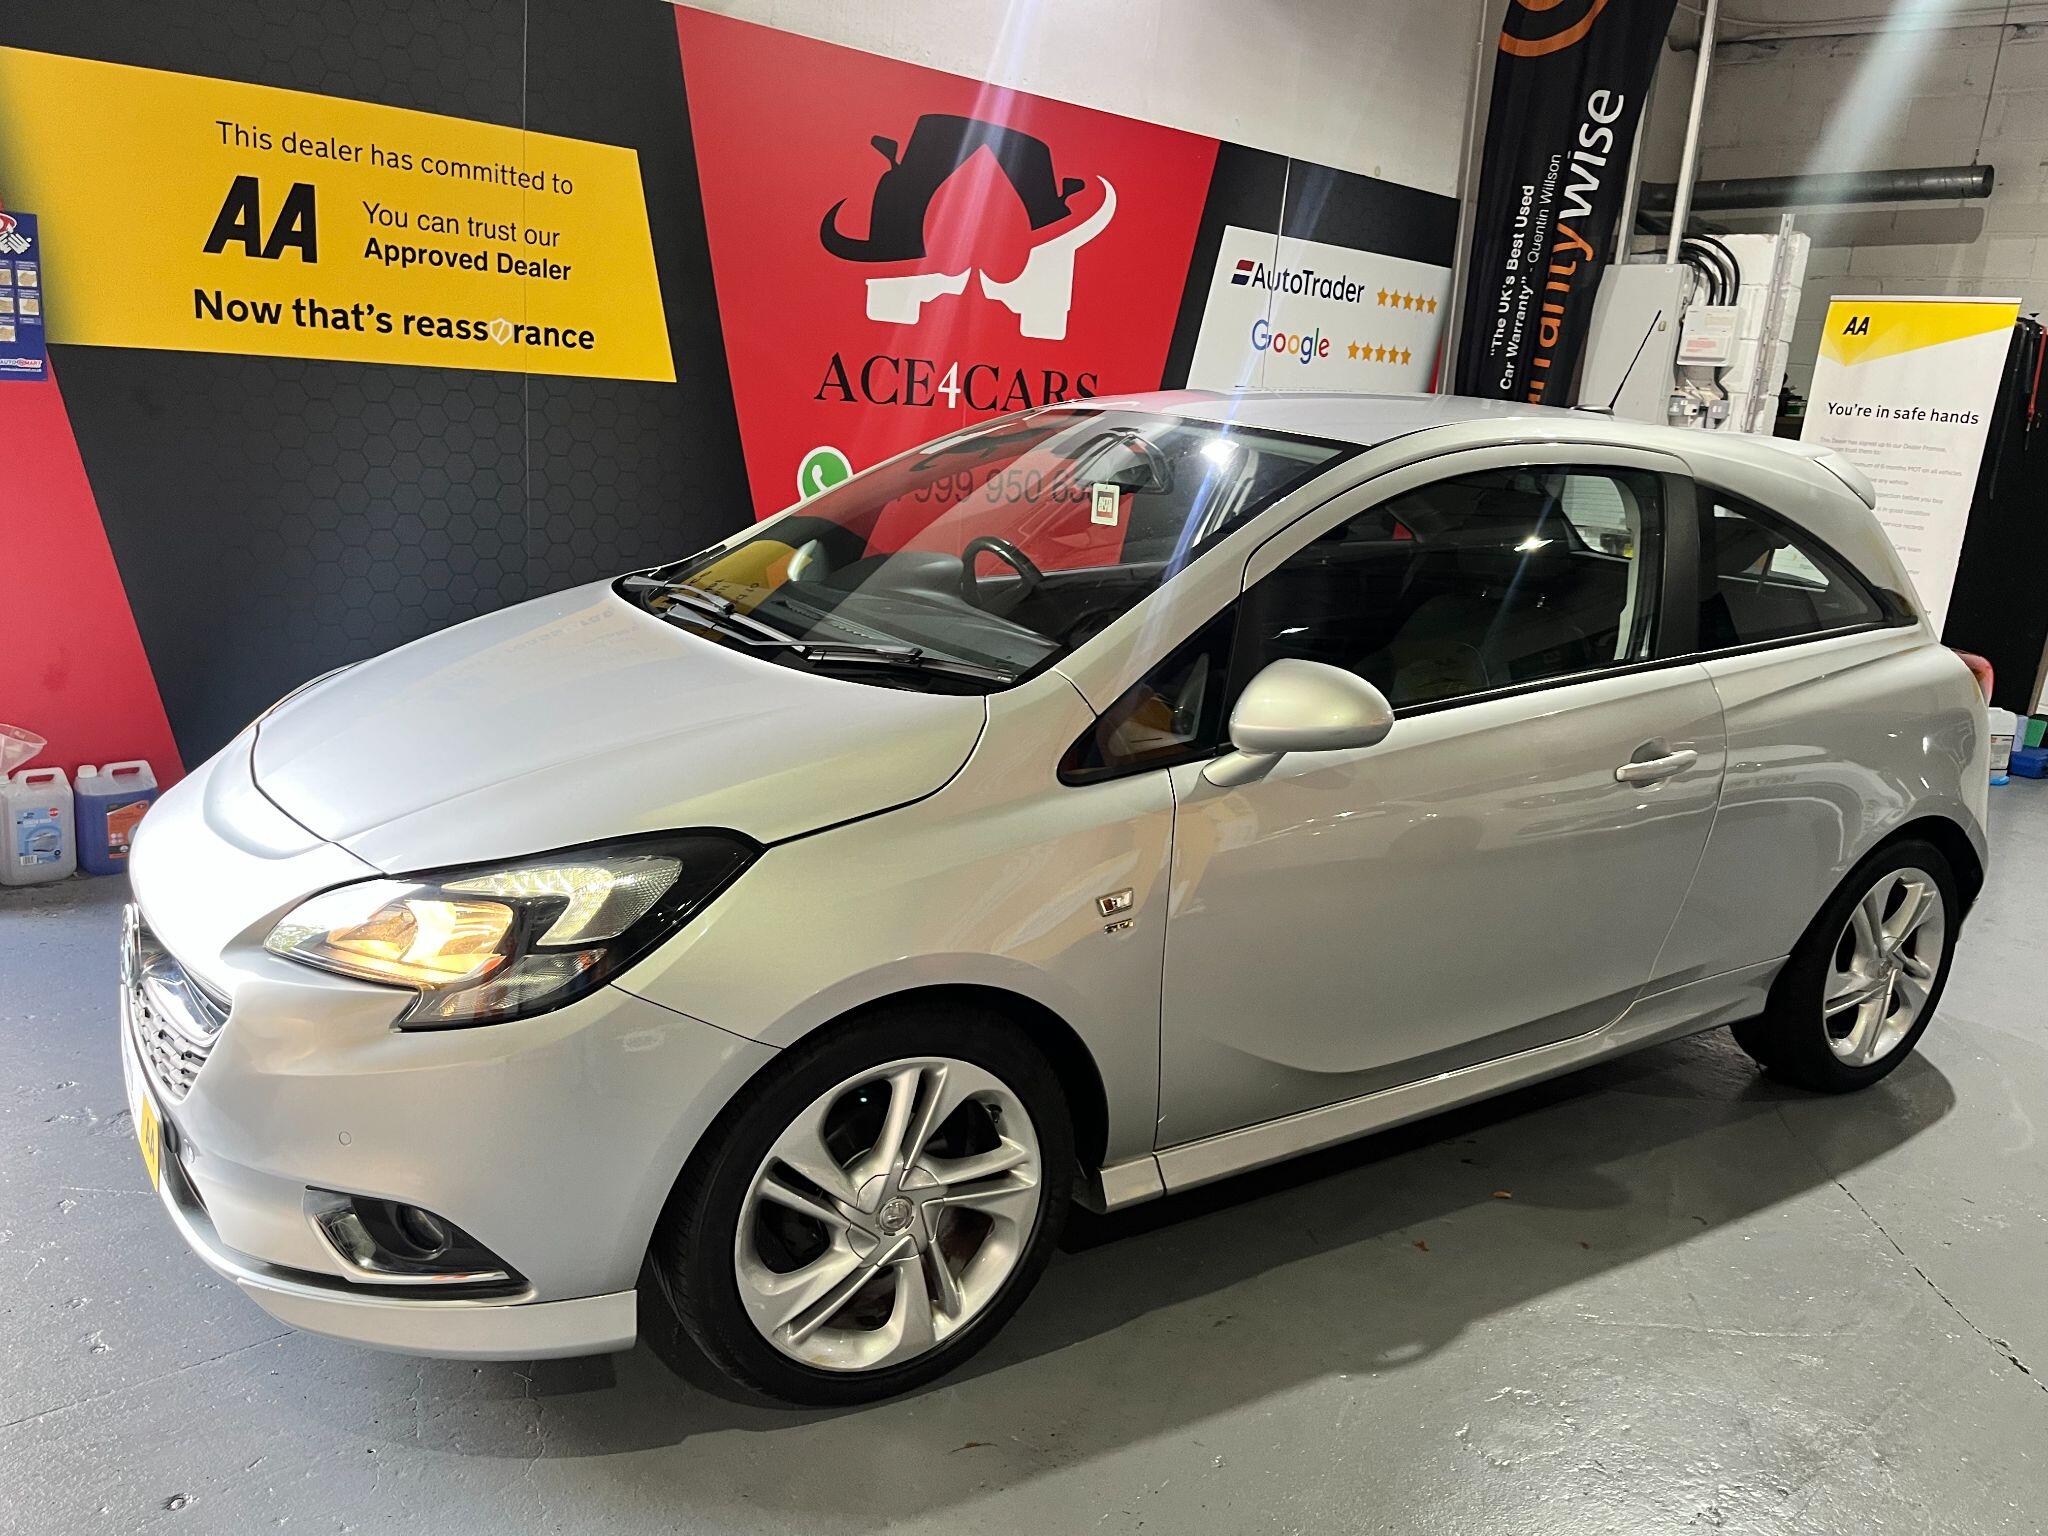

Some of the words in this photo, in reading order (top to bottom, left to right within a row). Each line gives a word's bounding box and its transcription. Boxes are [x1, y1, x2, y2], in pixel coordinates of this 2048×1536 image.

[215, 120, 273, 151] This
[281, 131, 364, 163] dealer
[371, 143, 414, 171] has
[421, 156, 545, 191] committed
[552, 173, 573, 195] to
[202, 174, 318, 264] AA
[362, 200, 408, 227] You
[417, 212, 460, 235] can
[467, 216, 517, 242] trust
[524, 227, 561, 247] our
[1514, 184, 1535, 229] Used
[363, 236, 489, 271] Approved
[496, 252, 572, 281] Dealer
[1499, 362, 1516, 390] Car
[1527, 208, 1550, 264] Quentin
[1539, 153, 1562, 204] Willson
[1506, 232, 1525, 271] Best
[1251, 262, 1366, 304] AutoTrader
[1498, 274, 1516, 314] UK's
[193, 288, 283, 325] Now
[291, 297, 394, 334] that's
[1842, 316, 1871, 336] AA
[1251, 319, 1331, 365] Google
[813, 351, 1099, 412] ACE4CARS
[1827, 402, 1872, 417] You're
[1875, 404, 1890, 418] in
[1893, 406, 1926, 421] safe
[1930, 409, 1980, 425] hands
[986, 468, 1042, 504] 950
